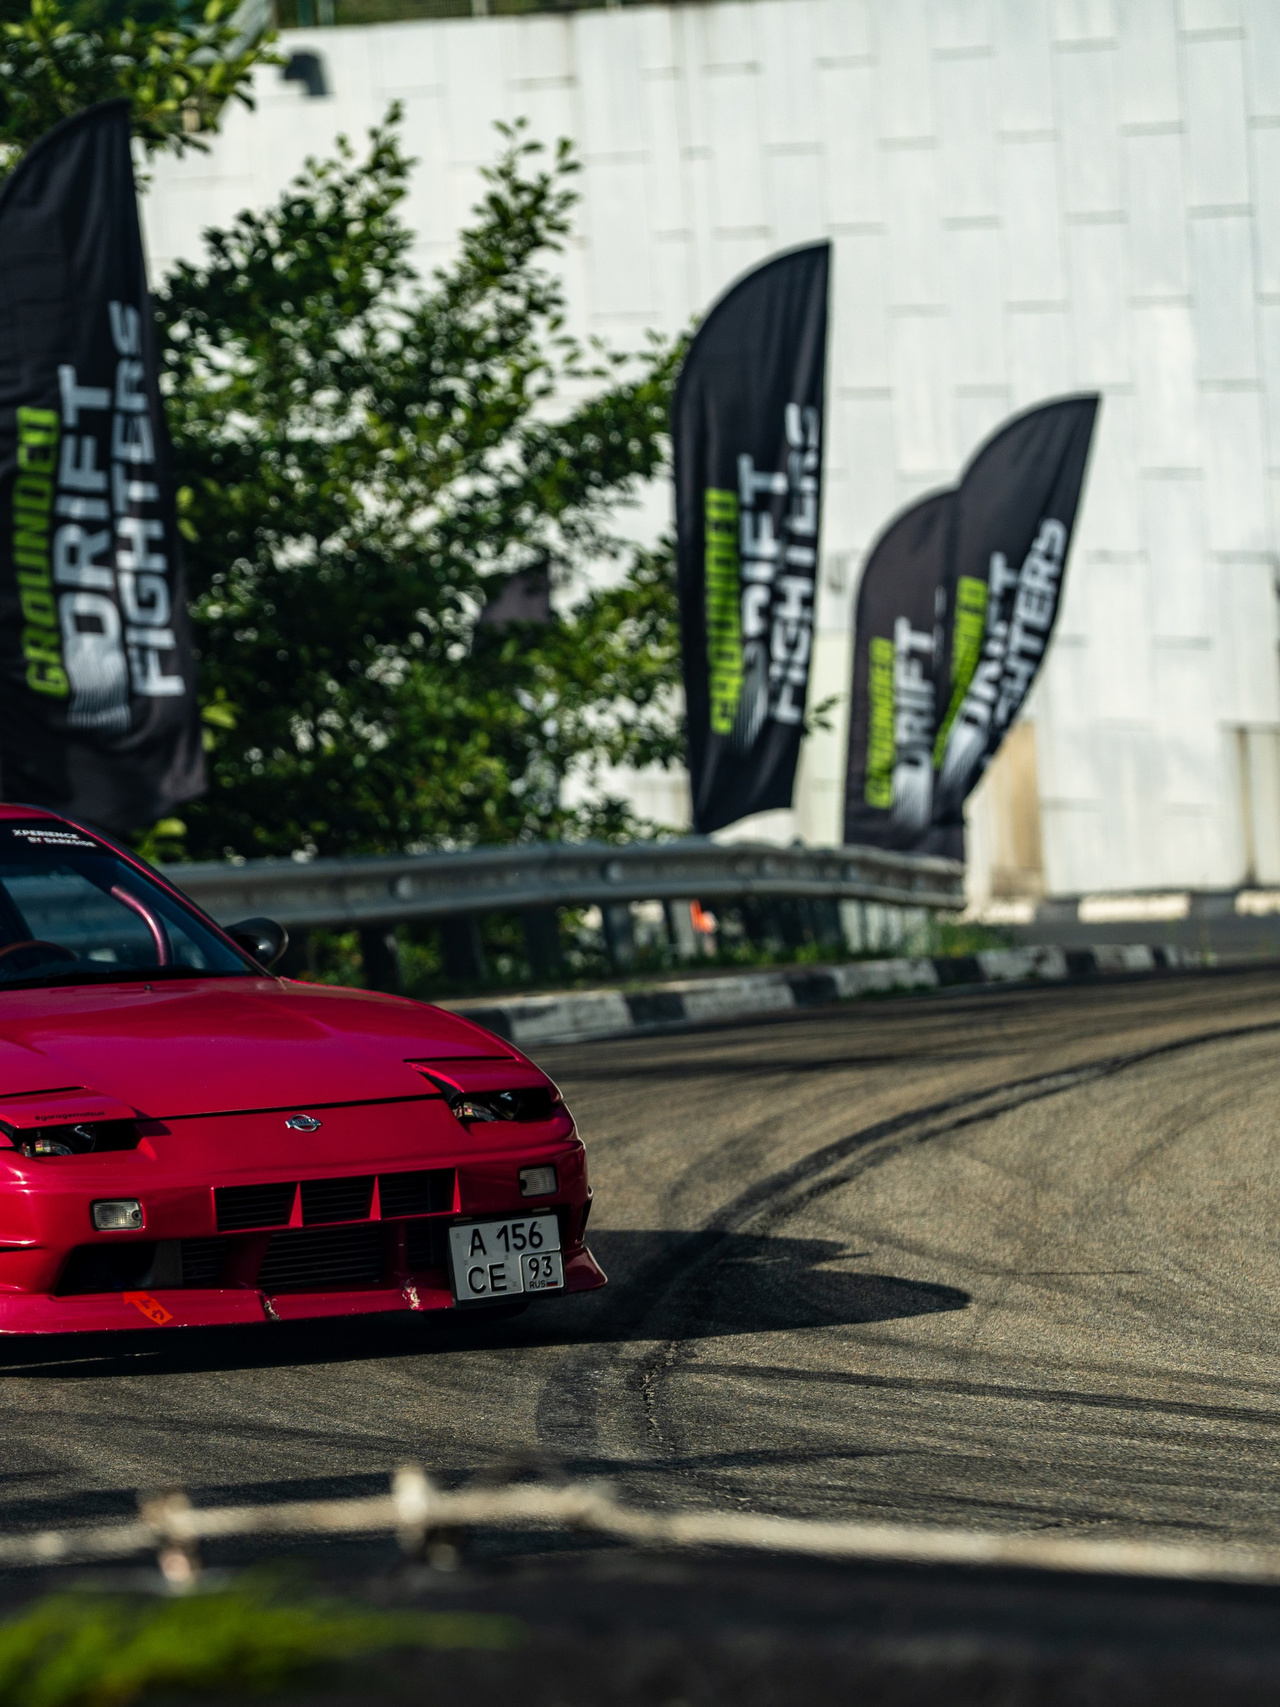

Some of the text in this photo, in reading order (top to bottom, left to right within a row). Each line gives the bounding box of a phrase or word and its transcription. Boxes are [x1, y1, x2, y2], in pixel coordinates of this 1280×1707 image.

[53, 363, 131, 728] DRIFT
[470, 1221, 543, 1257] A 156
[468, 1255, 553, 1293] CE 93
[529, 1279, 546, 1289] RUS
